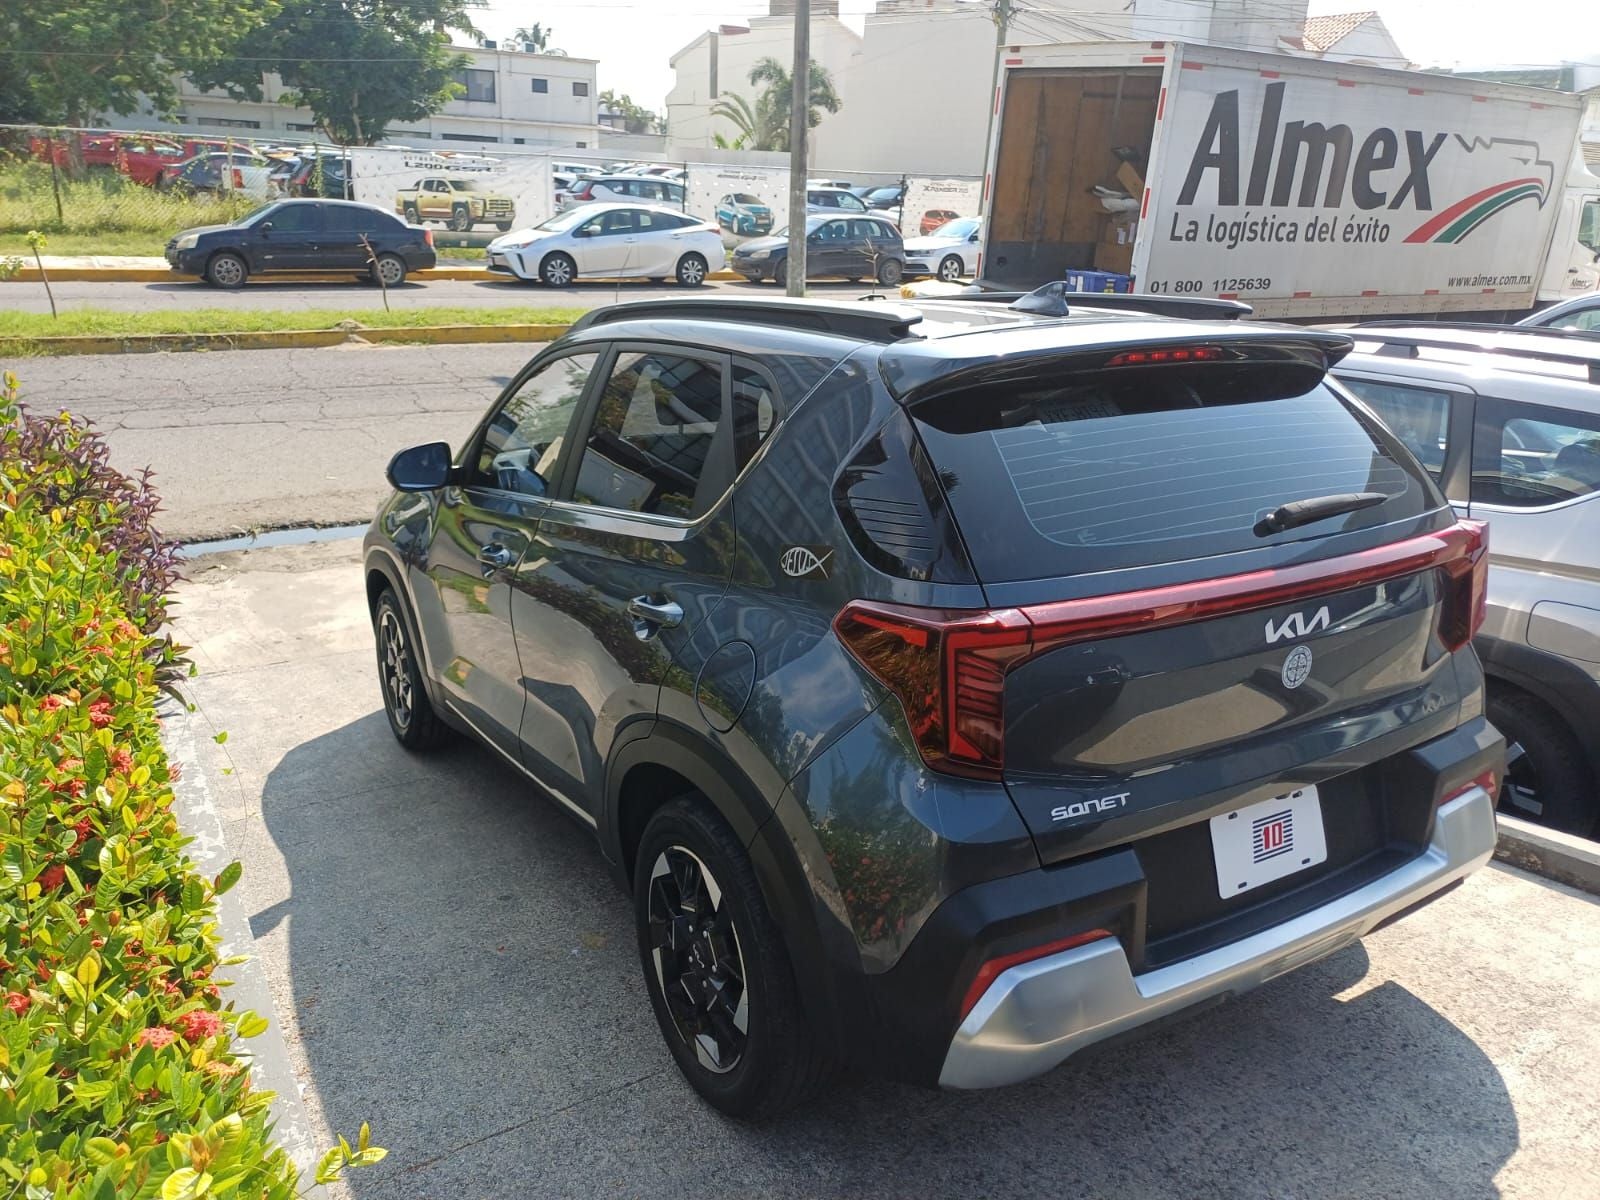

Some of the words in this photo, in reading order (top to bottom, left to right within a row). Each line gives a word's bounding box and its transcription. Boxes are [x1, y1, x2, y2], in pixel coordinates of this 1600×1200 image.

[1176, 81, 1448, 211] Almex
[1169, 211, 1199, 242] La
[1206, 211, 1298, 250] logística
[1304, 215, 1338, 243] del
[1342, 214, 1390, 243] éxito
[1150, 280, 1168, 293] 01
[1174, 280, 1203, 293] 800
[1212, 278, 1271, 292] 1125639
[1447, 273, 1532, 287] www.almex.com.mx
[1264, 606, 1330, 643] KIA
[1051, 792, 1131, 821] SONET
[1263, 822, 1283, 850] 10
